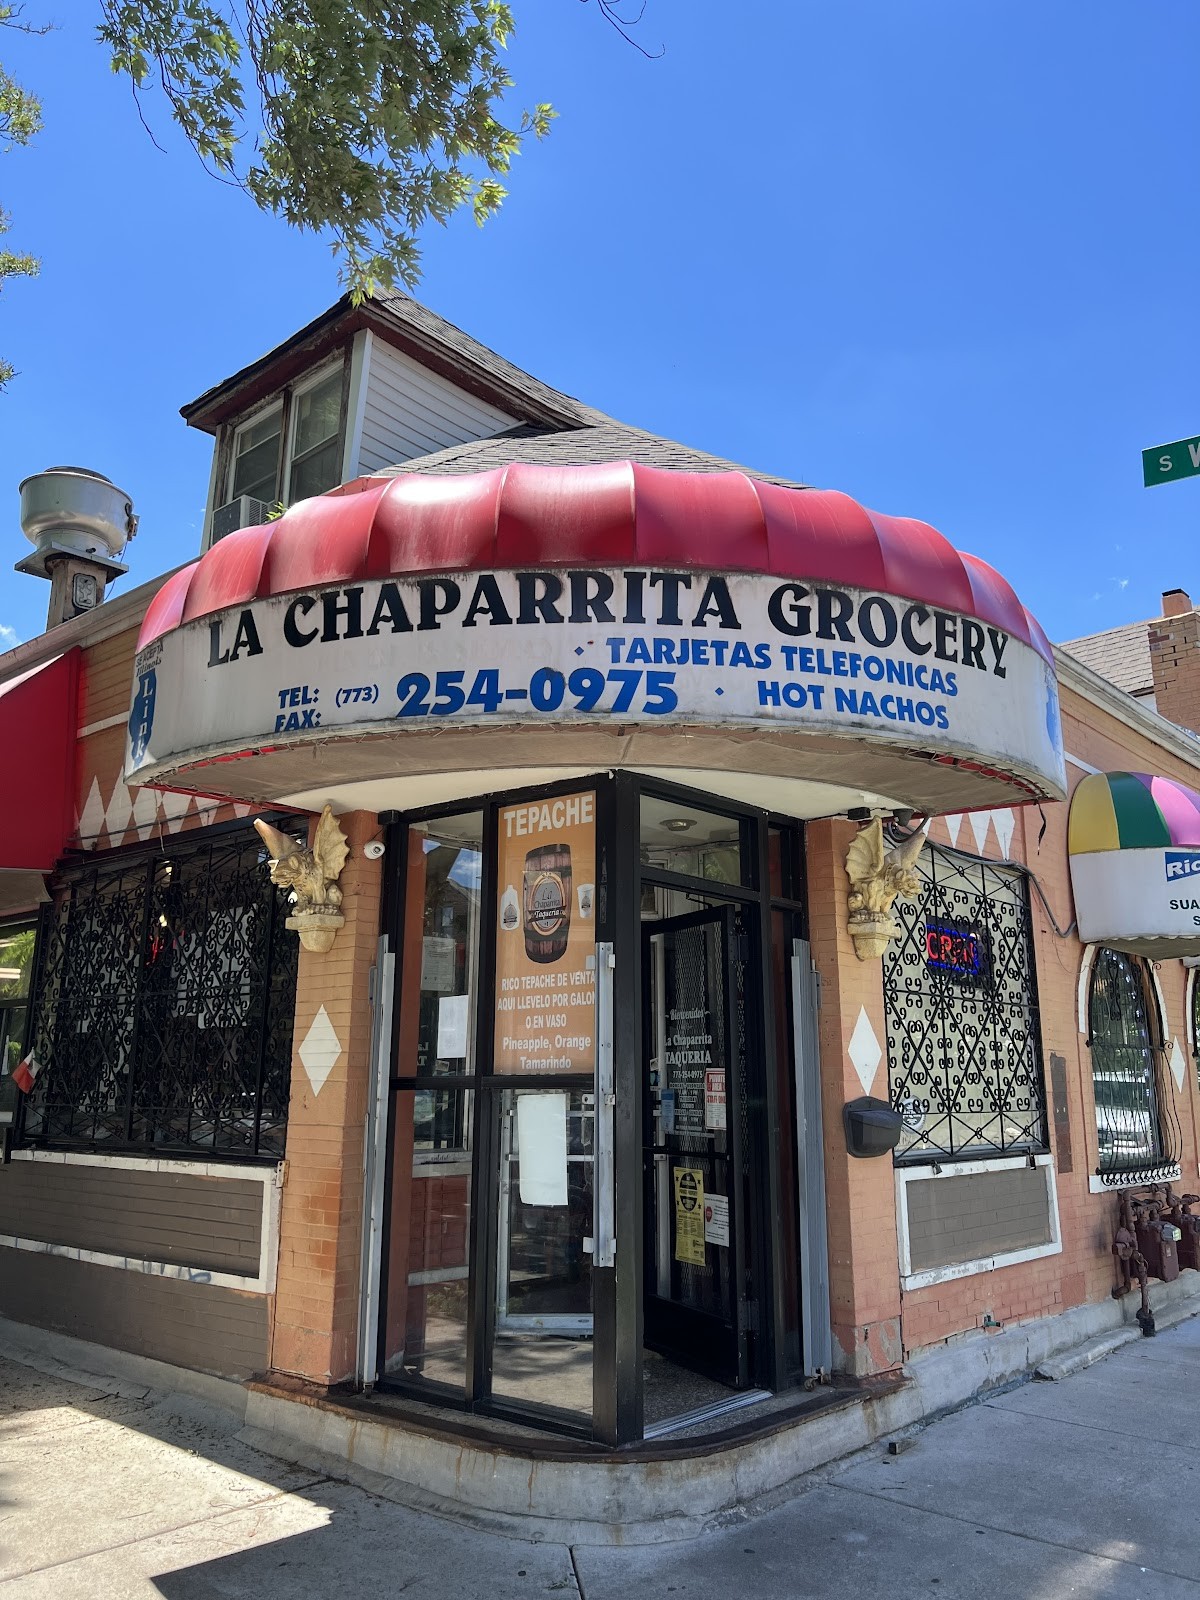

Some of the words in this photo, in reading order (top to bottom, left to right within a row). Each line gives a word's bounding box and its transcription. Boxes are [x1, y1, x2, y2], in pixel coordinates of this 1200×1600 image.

[1159, 455, 1173, 472] S
[206, 608, 263, 668] LA
[283, 570, 742, 648] CHAPARRITA
[767, 582, 1010, 679] GROCERY
[136, 657, 162, 677] Illinois
[605, 637, 772, 670] TARJETAS
[779, 645, 958, 697] TELEFONICAS
[278, 685, 319, 710] TEL:
[335, 684, 379, 709] (773)
[396, 667, 679, 718] 254-0975
[757, 680, 824, 710] HOT
[836, 689, 949, 730] NACHOS
[274, 708, 321, 733] FAX:
[504, 796, 593, 837] TEPACHE
[502, 977, 519, 991] RICO
[521, 974, 556, 989] TEPACHE
[557, 973, 568, 987] DE
[569, 971, 595, 985] VENTA
[497, 997, 516, 1010] AQUI
[517, 995, 550, 1009] LLEVELO
[552, 993, 569, 1007] POR
[525, 1015, 532, 1029] O
[533, 1014, 544, 1028] EN
[545, 1013, 567, 1028] VASO
[503, 1036, 552, 1051] Pineapple,
[555, 1034, 592, 1050] Orange
[673, 1034, 712, 1048] Chaparrita
[520, 1056, 571, 1069] Tamarindo
[665, 1051, 712, 1067] TAQUERIA
